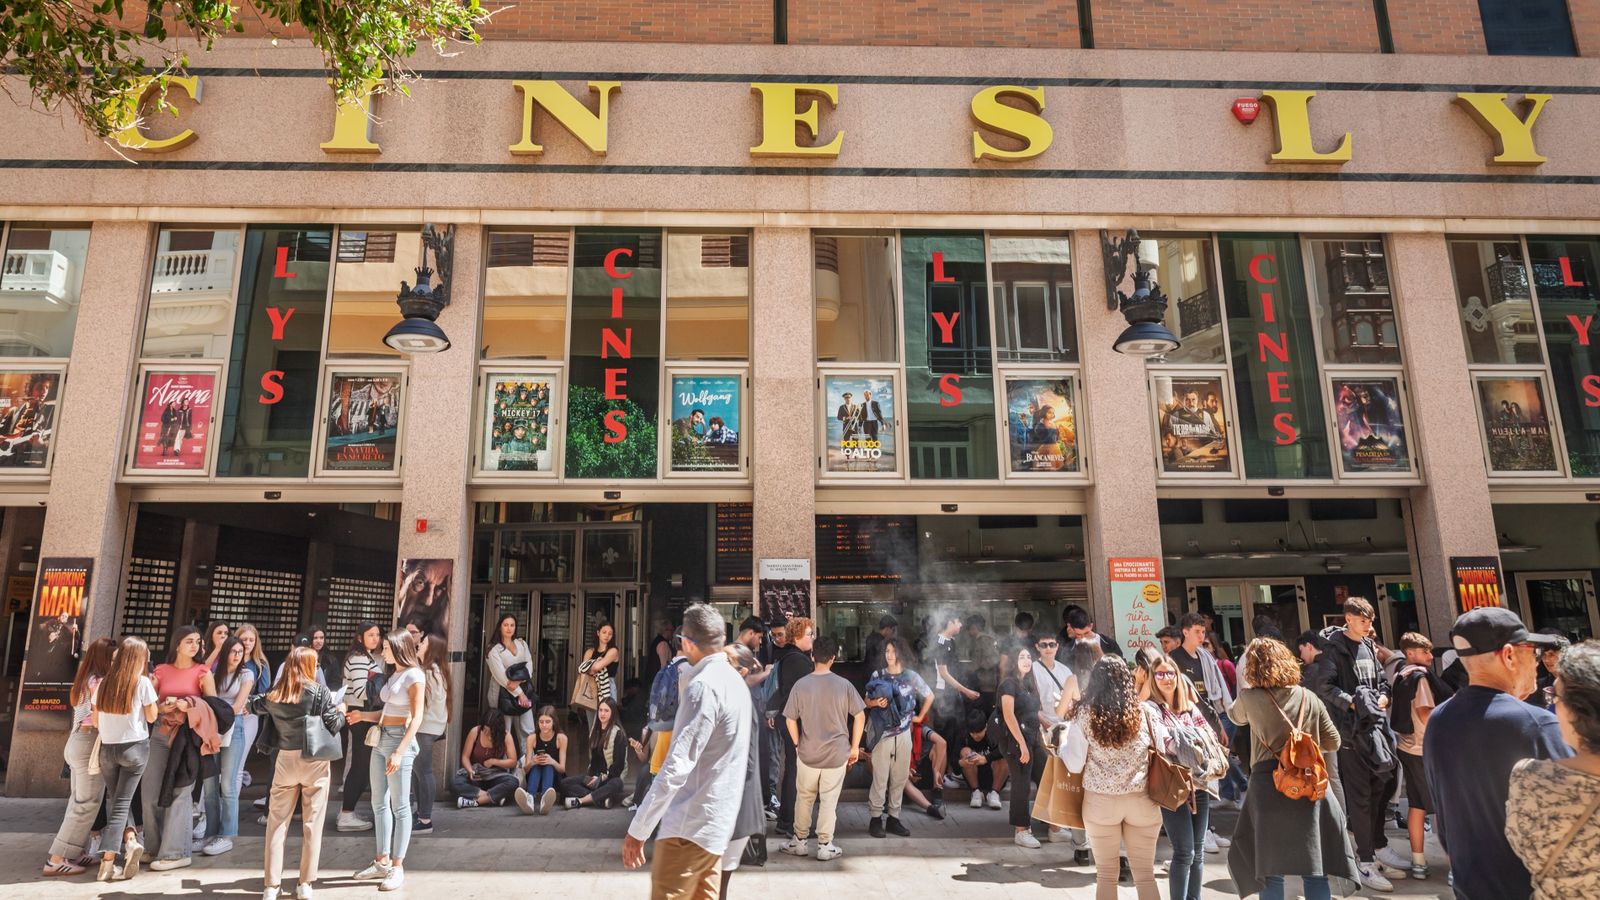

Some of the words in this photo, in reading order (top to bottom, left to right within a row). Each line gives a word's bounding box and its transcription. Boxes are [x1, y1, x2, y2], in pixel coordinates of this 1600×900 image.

[103, 74, 1053, 157] CINES
[259, 246, 296, 405] LYS
[933, 252, 962, 407] LYS
[1558, 256, 1600, 407] LYS
[601, 248, 633, 443] CINES
[1249, 255, 1296, 445] CINES
[149, 379, 211, 406] Anora
[679, 389, 732, 406] Wolfgang
[502, 409, 529, 417] MICKEY
[532, 409, 541, 417] 17
[852, 448, 881, 459] ALTO
[47, 572, 86, 586] WORKING
[1460, 569, 1497, 583] WORKING
[39, 585, 84, 616] MAN
[1132, 596, 1144, 609] La
[1459, 583, 1501, 612] MAN
[1126, 610, 1152, 622] niña
[1128, 624, 1138, 636] de
[1141, 624, 1151, 636] la
[1127, 637, 1157, 649] cabra
